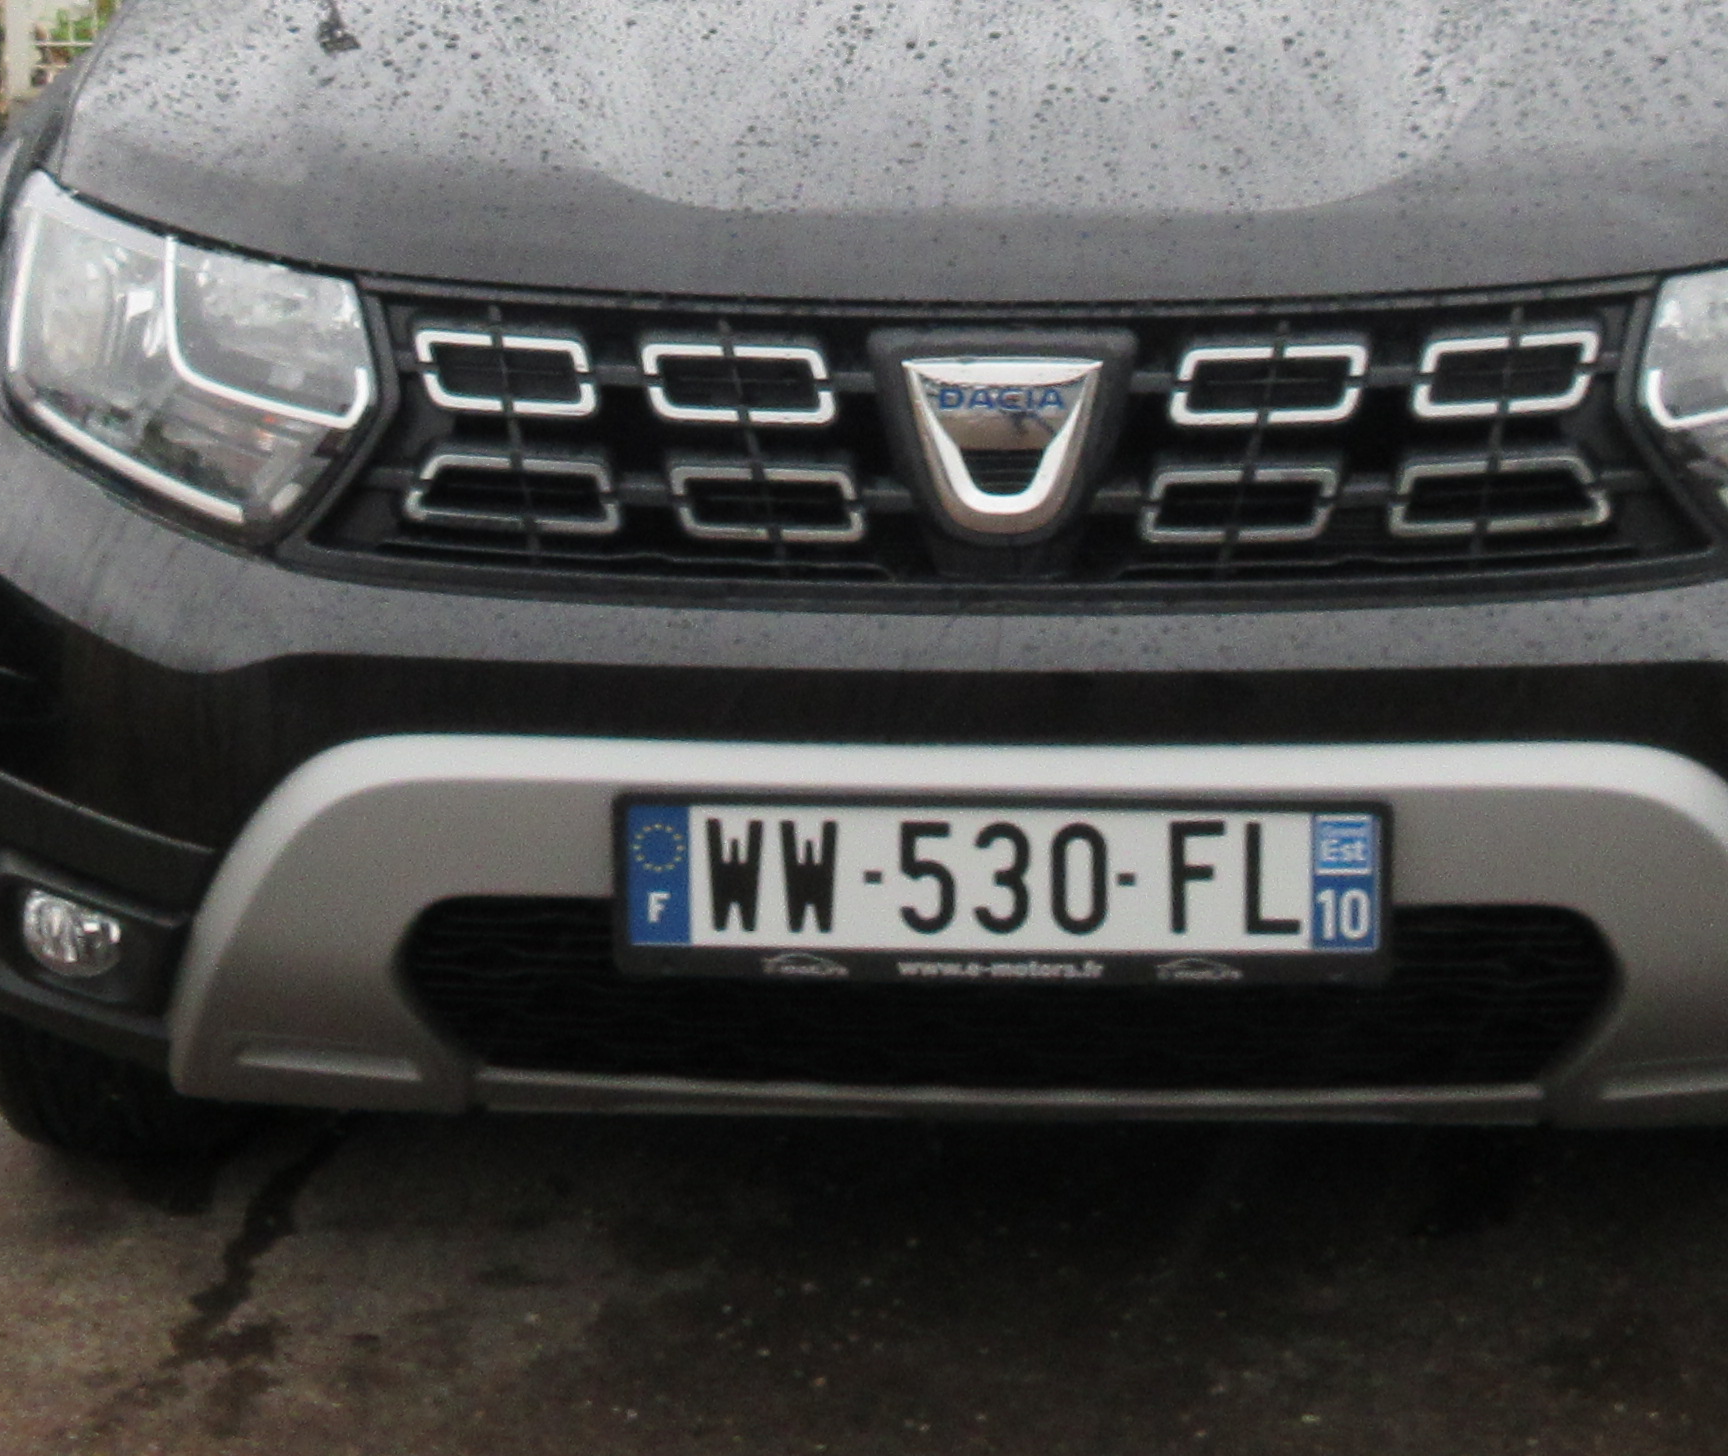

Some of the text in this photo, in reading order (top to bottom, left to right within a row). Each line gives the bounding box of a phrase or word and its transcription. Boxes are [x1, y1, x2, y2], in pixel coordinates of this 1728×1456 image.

[939, 388, 1066, 410] DACIA
[706, 818, 1302, 935] WW-530-FL
[647, 891, 671, 923] F
[1318, 888, 1371, 940] 10
